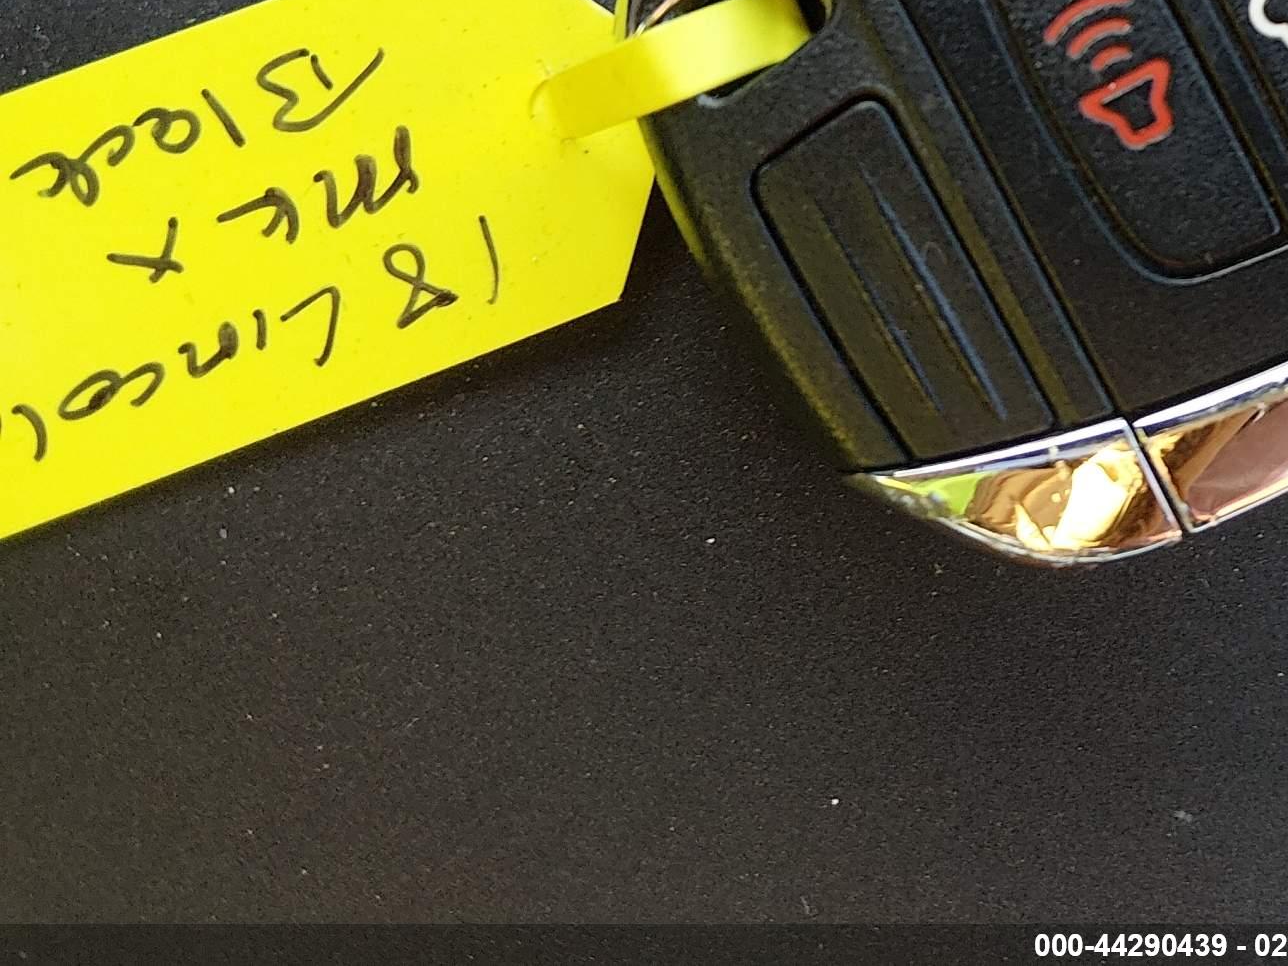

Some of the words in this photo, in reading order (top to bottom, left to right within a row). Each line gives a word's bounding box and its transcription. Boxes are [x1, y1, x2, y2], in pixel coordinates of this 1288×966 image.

[7, 48, 385, 210] Black
[381, 216, 501, 329] 18
[0, 284, 340, 463] Lincol
